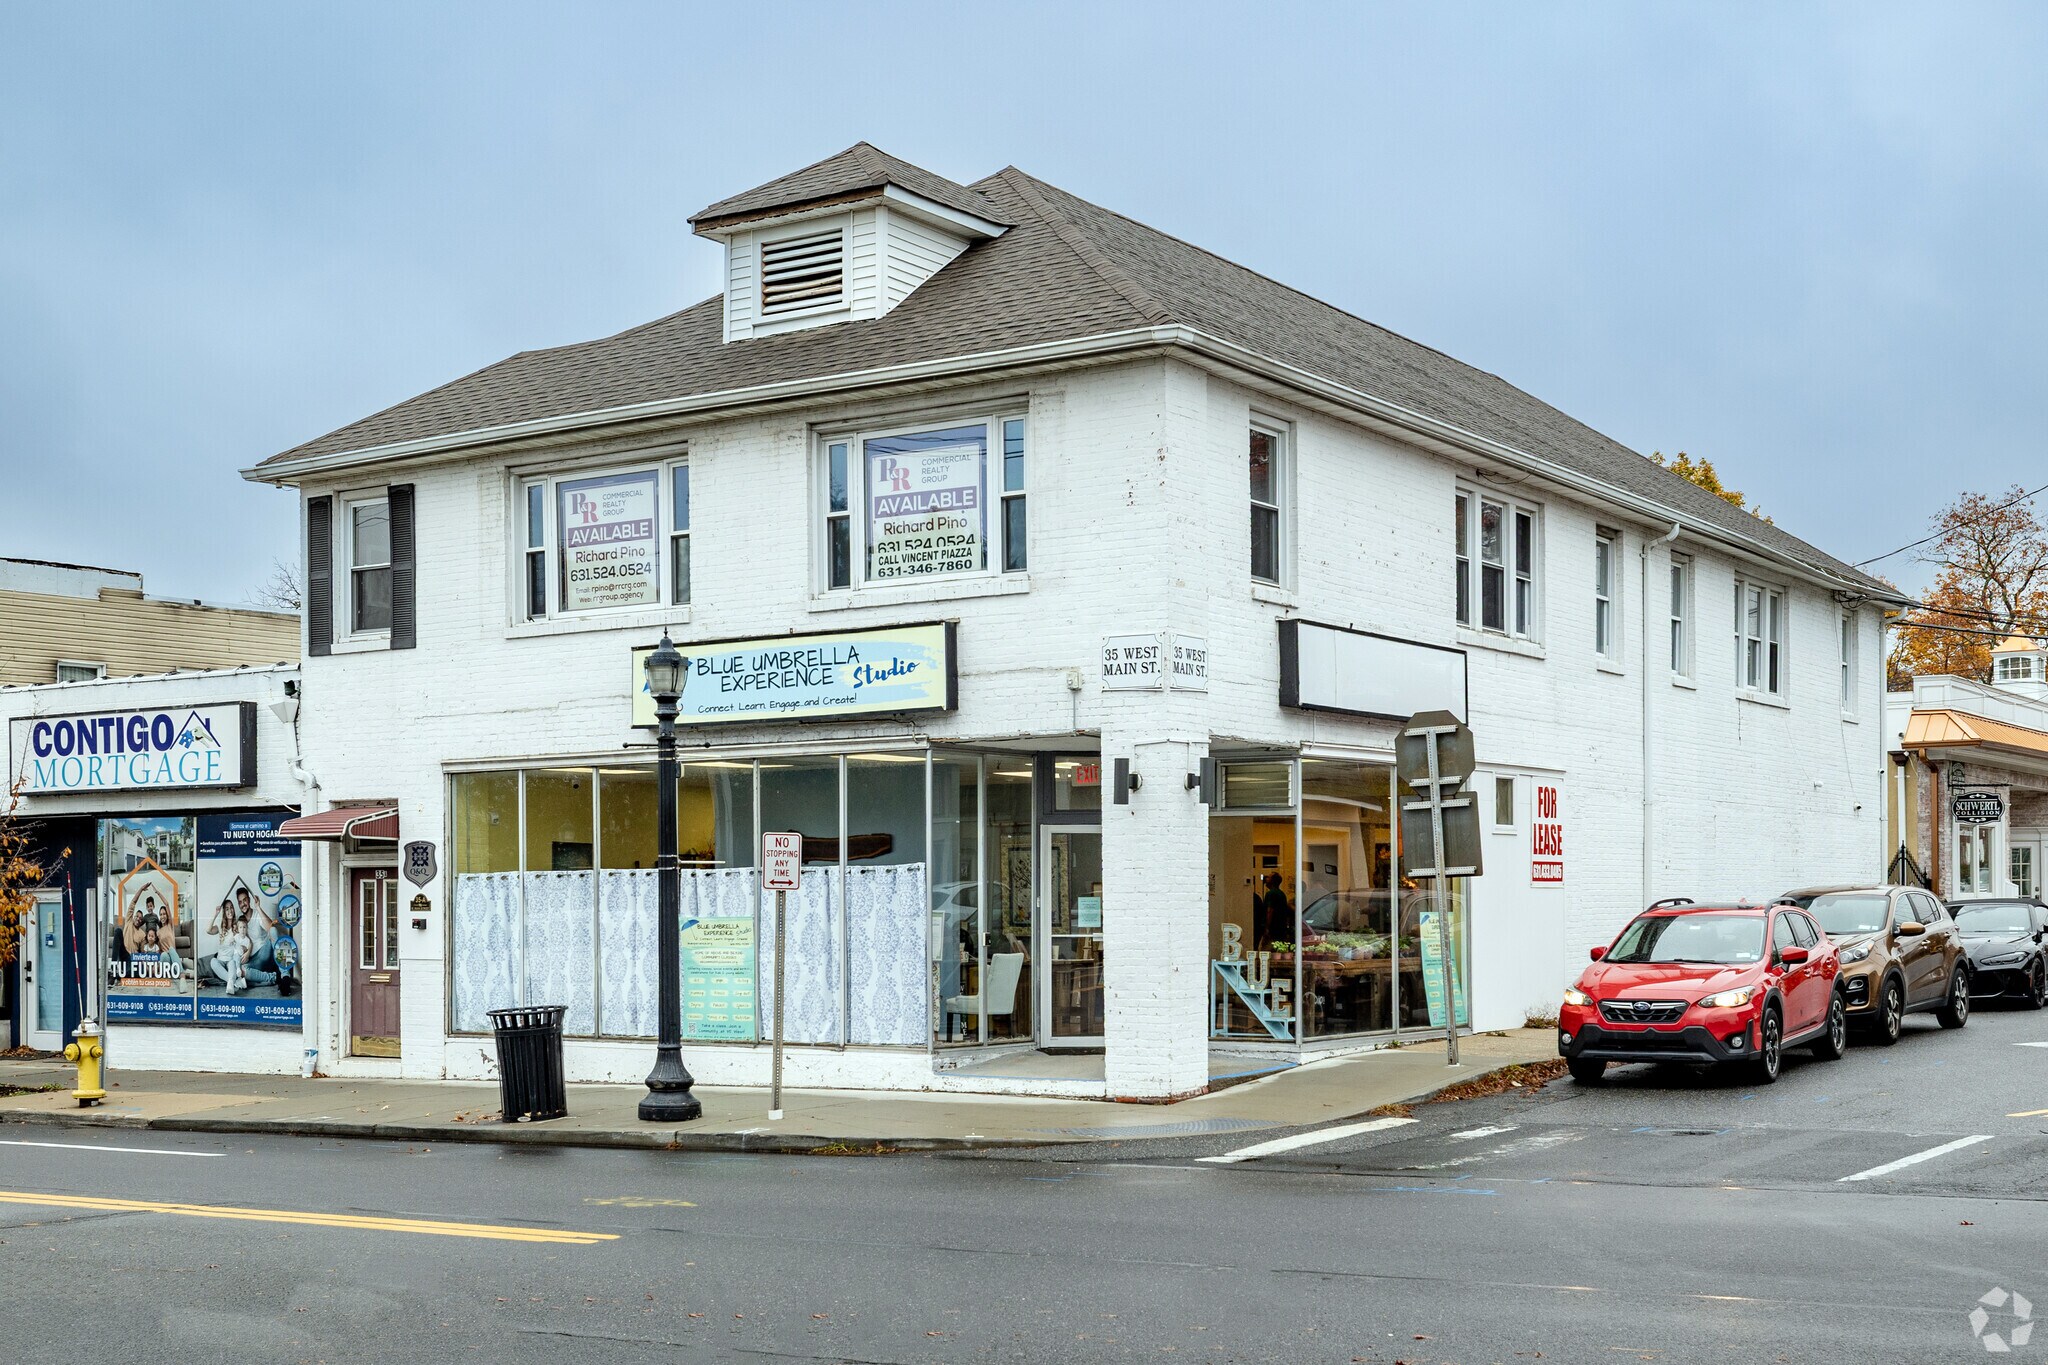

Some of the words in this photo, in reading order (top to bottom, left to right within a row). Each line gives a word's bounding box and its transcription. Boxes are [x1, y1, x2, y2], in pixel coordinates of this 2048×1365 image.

[922, 454, 972, 466] COMMERCIAL
[922, 466, 950, 474] REALTY
[922, 474, 948, 484] GROUP
[602, 490, 643, 500] COMMERCIAL
[878, 490, 974, 514] AVAILABLE
[602, 500, 626, 508] REALTY
[602, 508, 624, 516] GROUP
[572, 522, 648, 544] AVAILABLE
[884, 518, 934, 536] Richard
[938, 516, 968, 530] Pino
[878, 534, 976, 554] 6315240524
[576, 548, 618, 564] Richard
[620, 546, 646, 558] Pino
[878, 554, 899, 566] CALL
[902, 550, 939, 563] VINCENT
[941, 547, 972, 559] PIAZZA
[570, 562, 652, 582] 631.524.0524
[878, 559, 972, 578] 631-346-7860
[697, 656, 744, 676] BLUE
[752, 645, 860, 670] UMBRELLA
[1104, 648, 1118, 661] 35
[1124, 646, 1158, 660] WEST
[1174, 646, 1183, 659] 35
[1185, 648, 1206, 662] WEST
[720, 668, 834, 692] EXPERIENCE
[852, 656, 920, 689] Studio
[1104, 662, 1137, 676] MAIN
[1140, 662, 1161, 674] ST.
[1172, 661, 1194, 676] MAIN
[1196, 664, 1208, 678] ST.
[822, 693, 857, 705] Create!
[33, 714, 174, 758] CONTIGO
[32, 750, 222, 788] MORTGAGE
[1076, 766, 1099, 784] EXIT
[1538, 786, 1557, 818] FOR
[1956, 802, 2000, 810] SCHWERTL
[775, 838, 789, 848] NO
[1533, 823, 1562, 856] LEASE
[410, 868, 429, 876] Q&Q
[111, 962, 126, 977] TU
[131, 962, 181, 978] FUTURO
[206, 1005, 245, 1013] 631-609-9108
[261, 1006, 301, 1015] 631-609-9108
